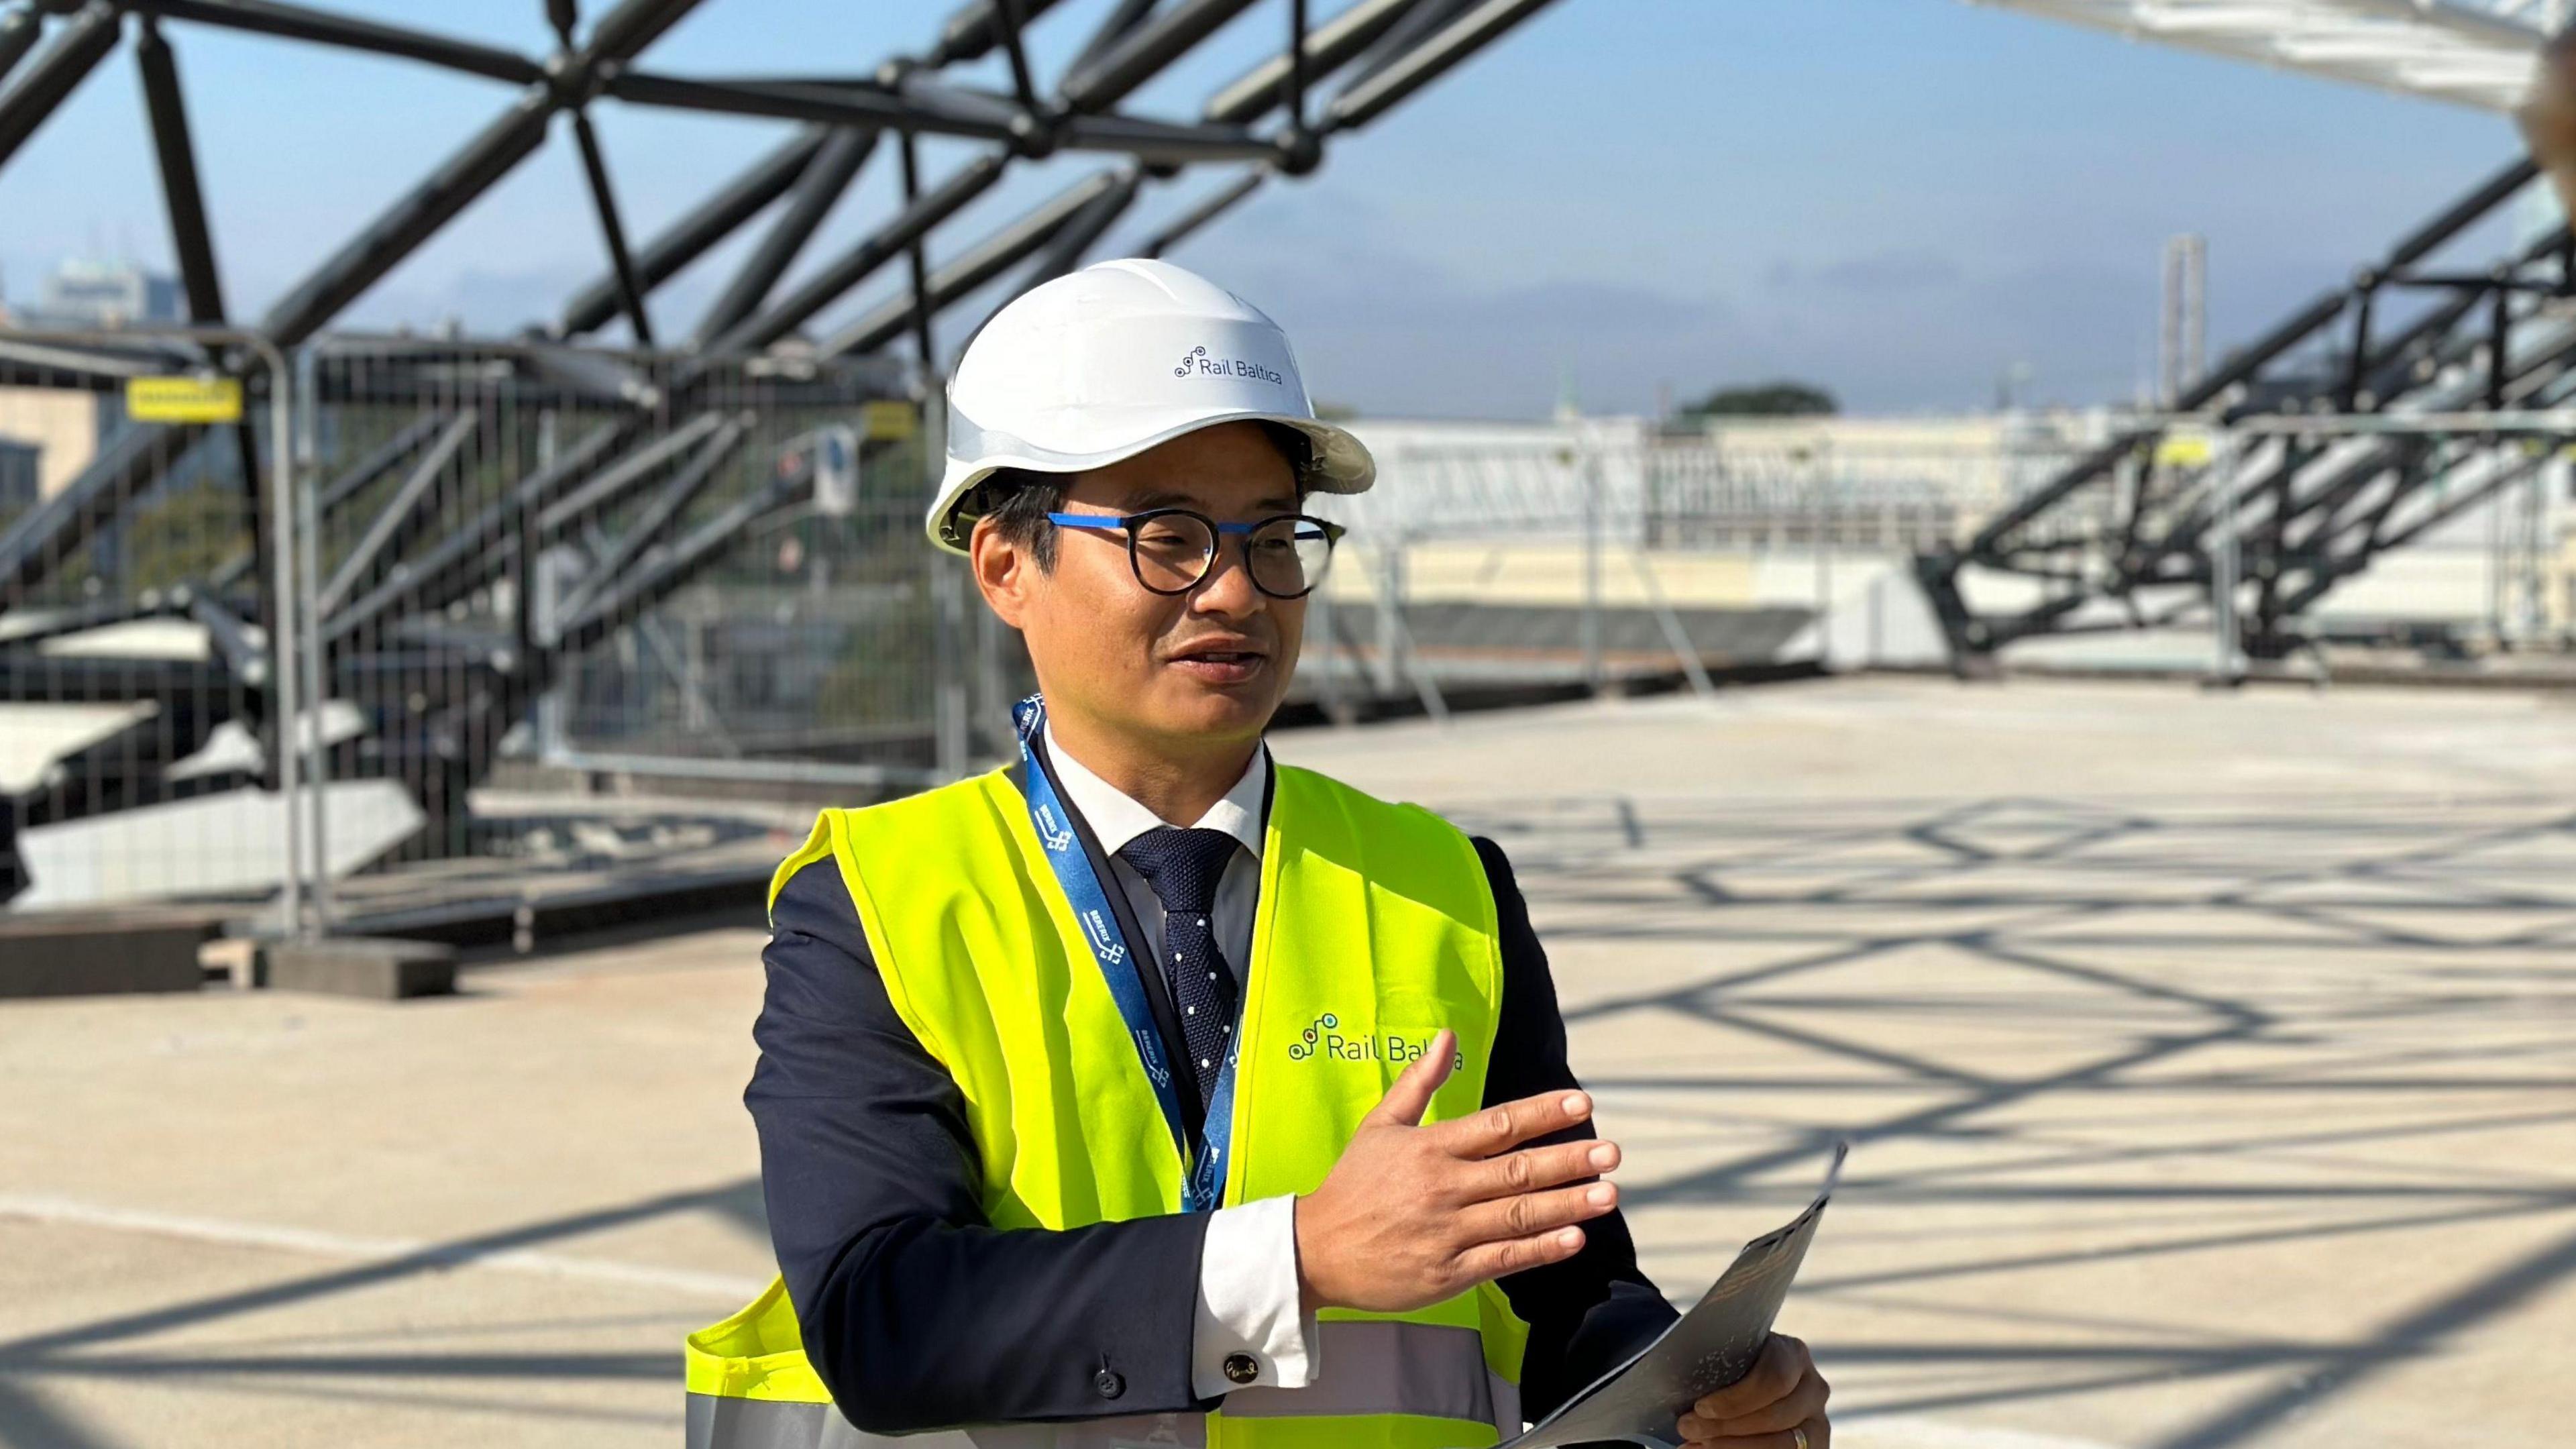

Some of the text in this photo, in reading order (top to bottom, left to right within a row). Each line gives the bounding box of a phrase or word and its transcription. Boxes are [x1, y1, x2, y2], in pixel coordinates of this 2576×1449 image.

[1199, 359, 1282, 385] Rail Baltica
[1089, 909, 1111, 943] BERERIX
[1328, 1034, 1463, 1070] Rail Bala
